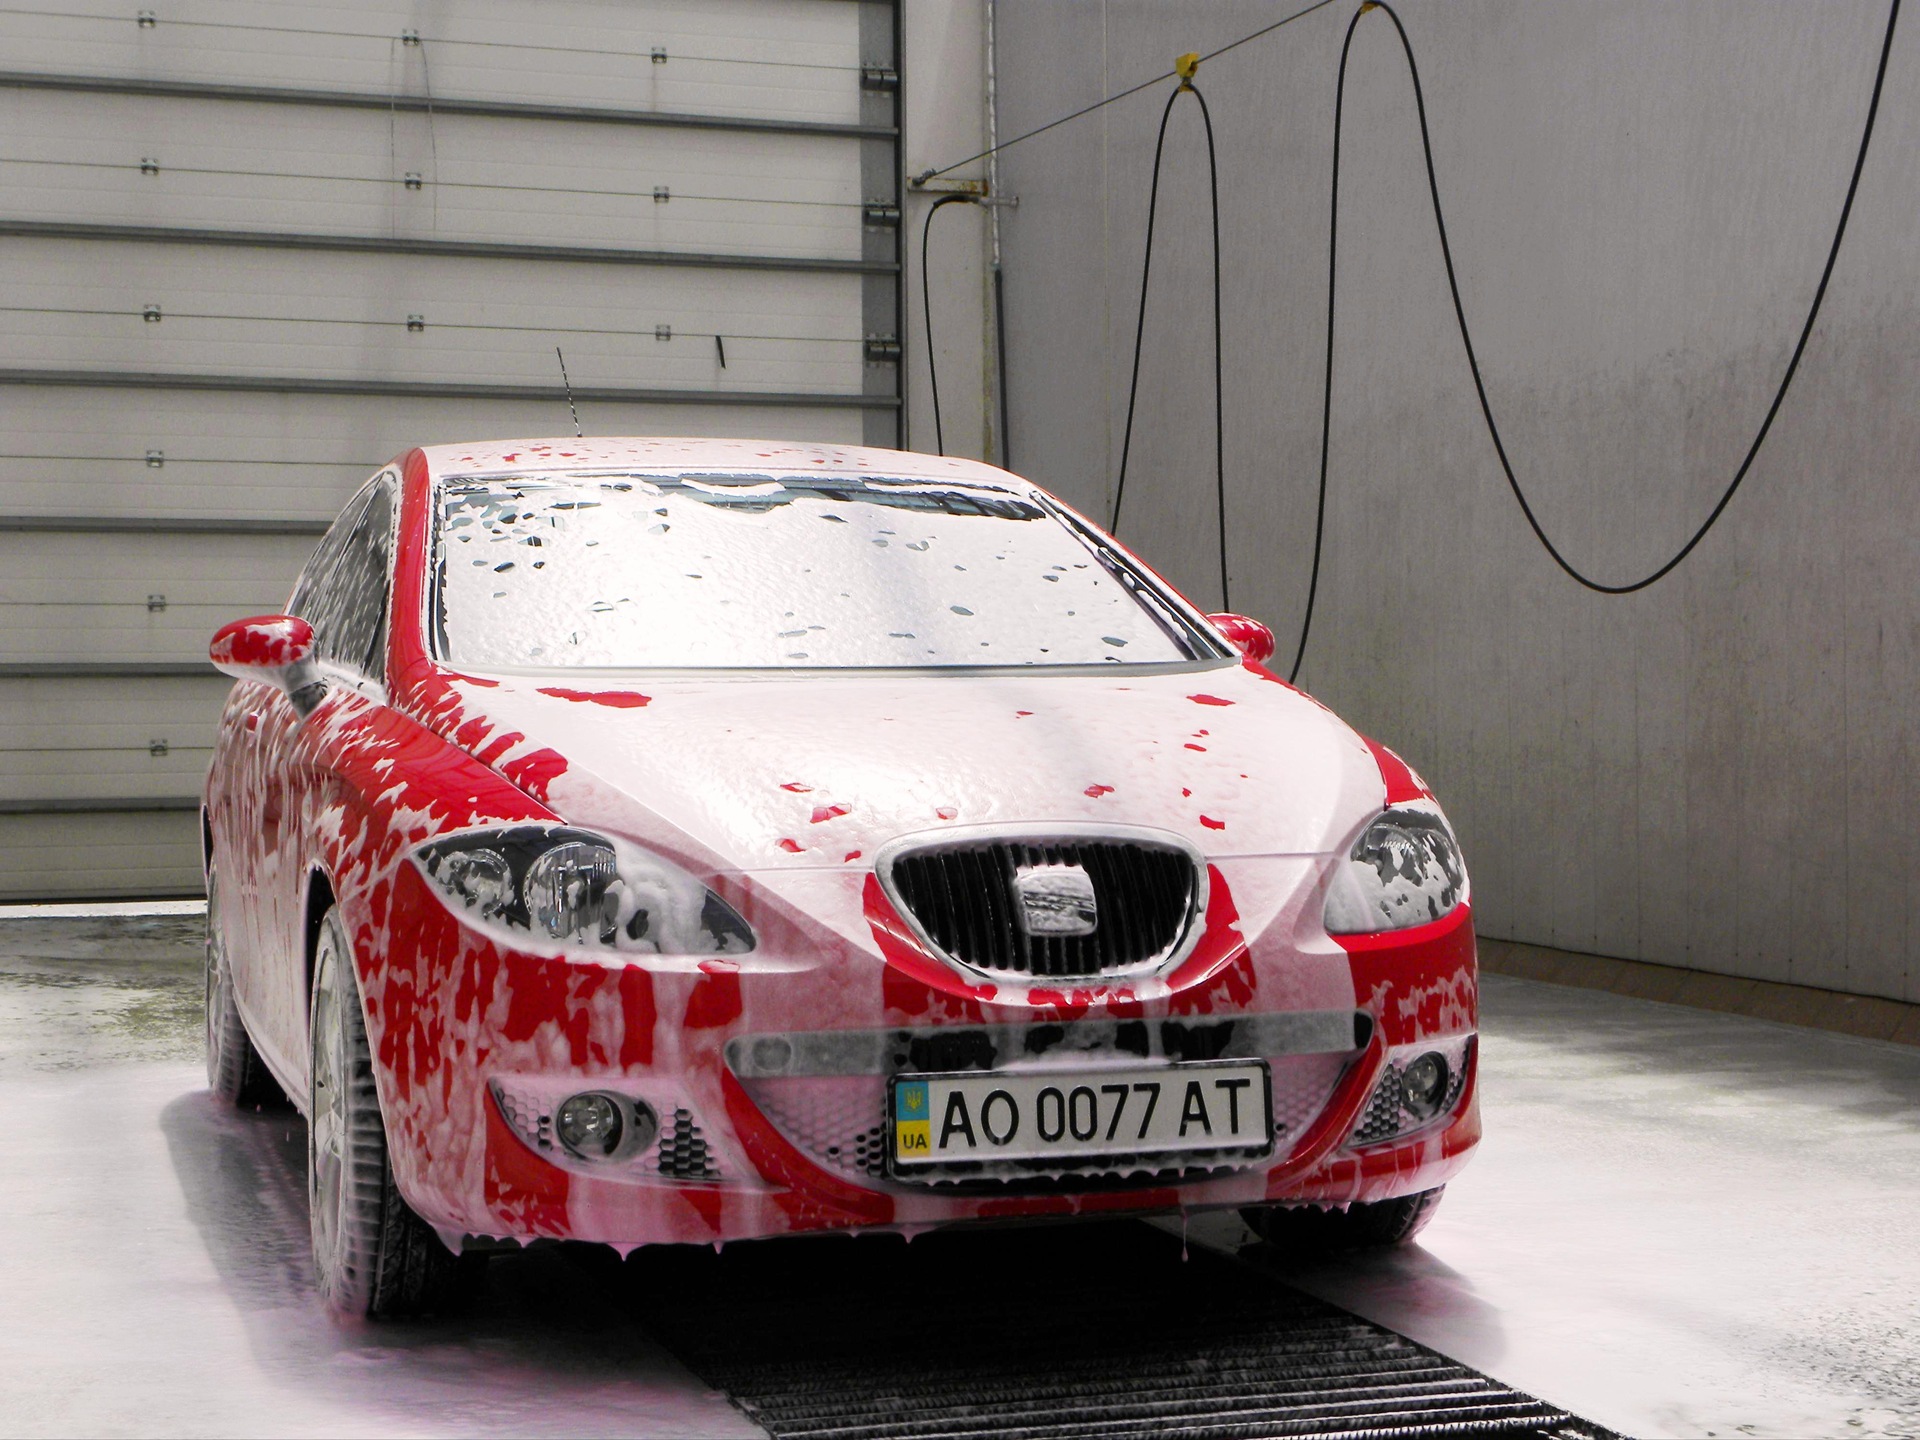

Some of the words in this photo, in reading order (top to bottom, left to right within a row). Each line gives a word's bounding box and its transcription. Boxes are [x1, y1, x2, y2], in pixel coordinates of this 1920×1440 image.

[938, 1089, 1020, 1149] AO
[1036, 1083, 1161, 1142] 0077
[1178, 1078, 1251, 1137] AT
[903, 1134, 928, 1149] UA
